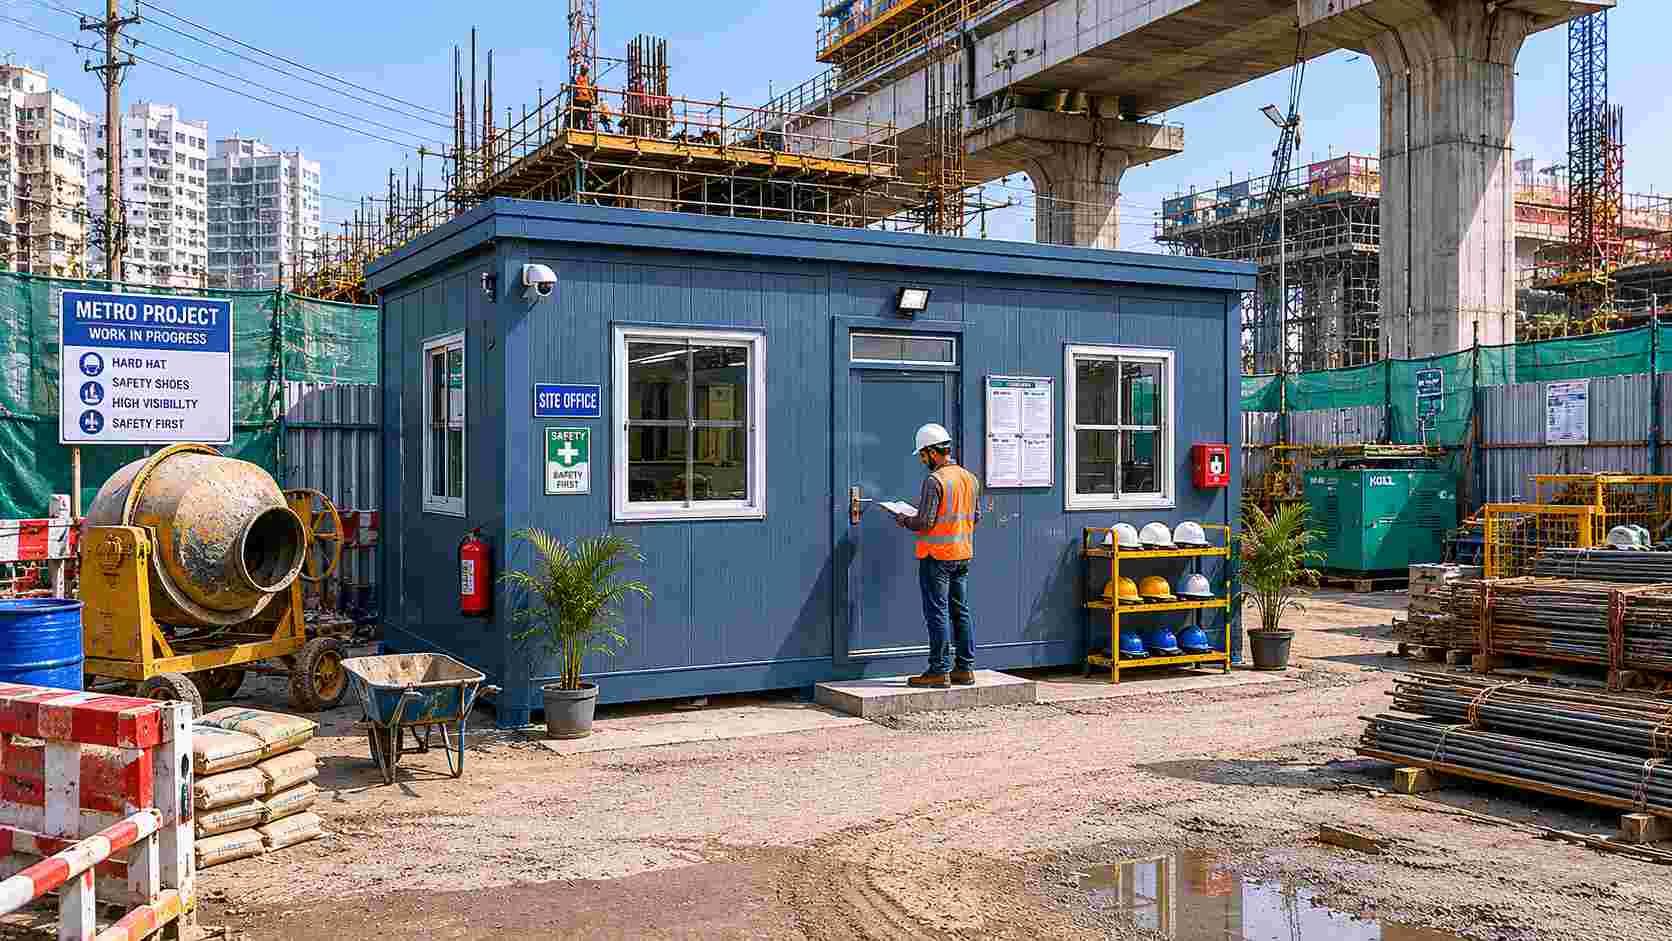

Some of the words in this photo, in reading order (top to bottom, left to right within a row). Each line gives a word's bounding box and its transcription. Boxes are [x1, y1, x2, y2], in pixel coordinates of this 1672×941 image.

[76, 300, 136, 320] METRO
[143, 304, 219, 325] PROJECT
[89, 327, 126, 341] WORK
[130, 329, 142, 342] IN
[145, 330, 208, 345] PROGRESS
[112, 357, 143, 369] HARD
[145, 359, 167, 369] HAT
[112, 378, 152, 389] SAFETY
[154, 379, 190, 390] SHOES
[112, 398, 140, 409] HIGH
[539, 392, 561, 409] SITE
[563, 392, 597, 409] OFFICE
[112, 418, 153, 429] SAFETY
[155, 419, 184, 429] FIRST
[551, 431, 586, 441] SAFETY
